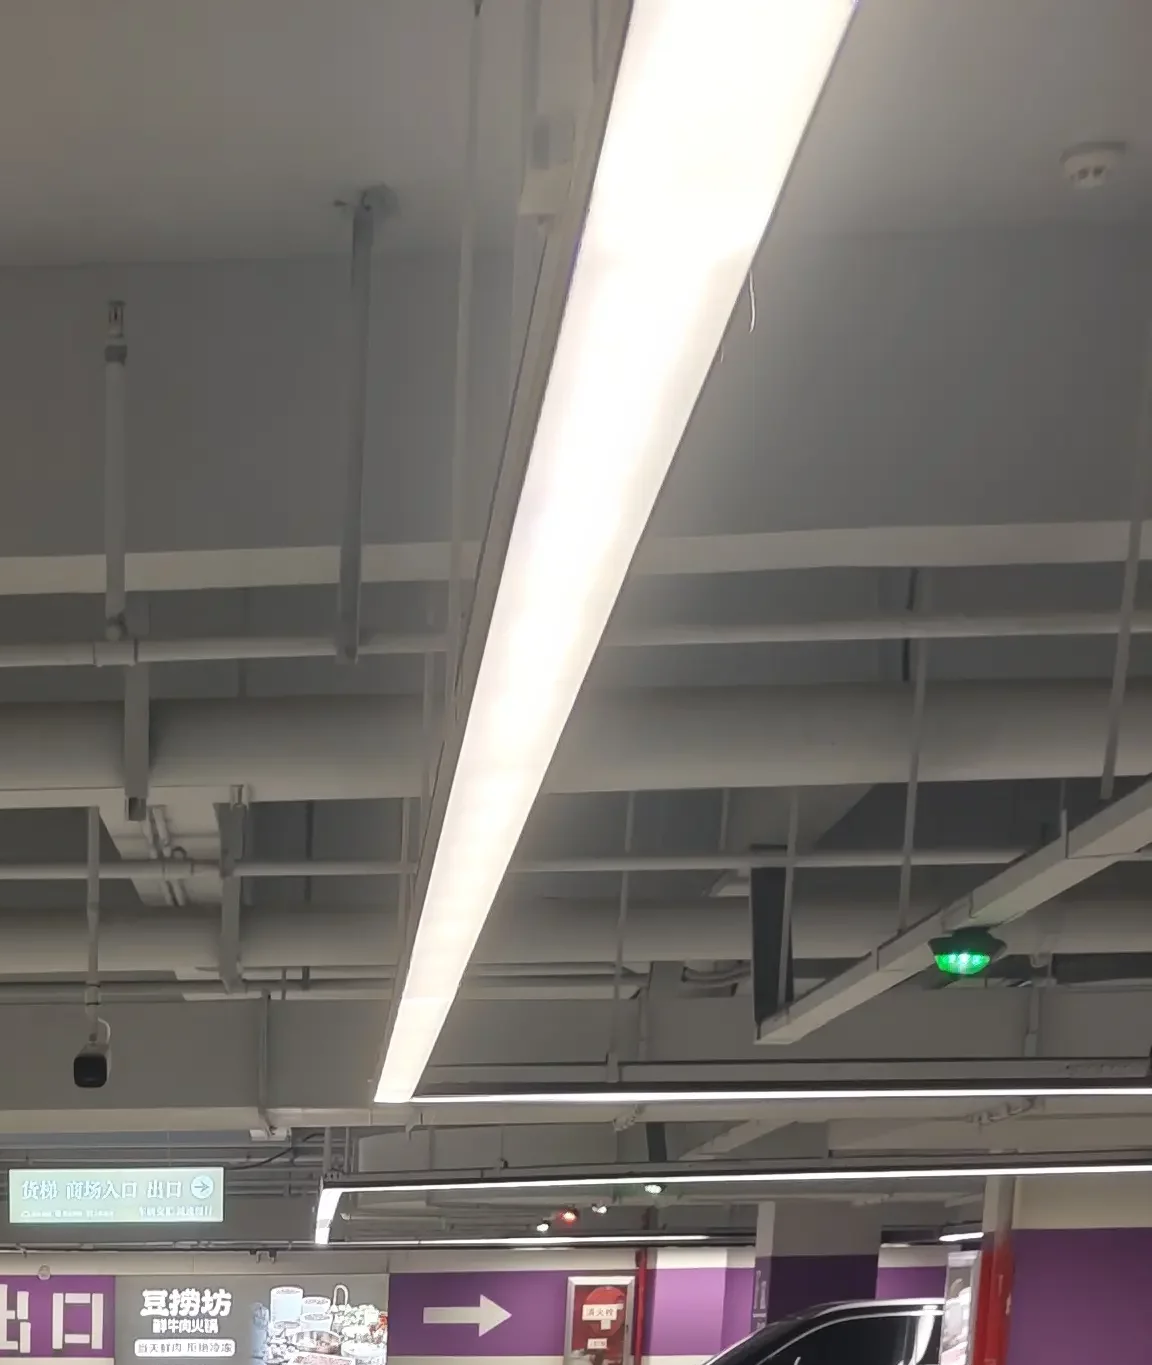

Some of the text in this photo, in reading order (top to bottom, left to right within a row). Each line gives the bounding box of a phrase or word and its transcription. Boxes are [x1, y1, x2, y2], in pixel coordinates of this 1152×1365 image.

[21, 1179, 182, 1200] 货梯 商场入口 出口
[140, 1288, 232, 1317] 豆捞坊
[152, 1318, 219, 1334] 鲜牛肉火锅
